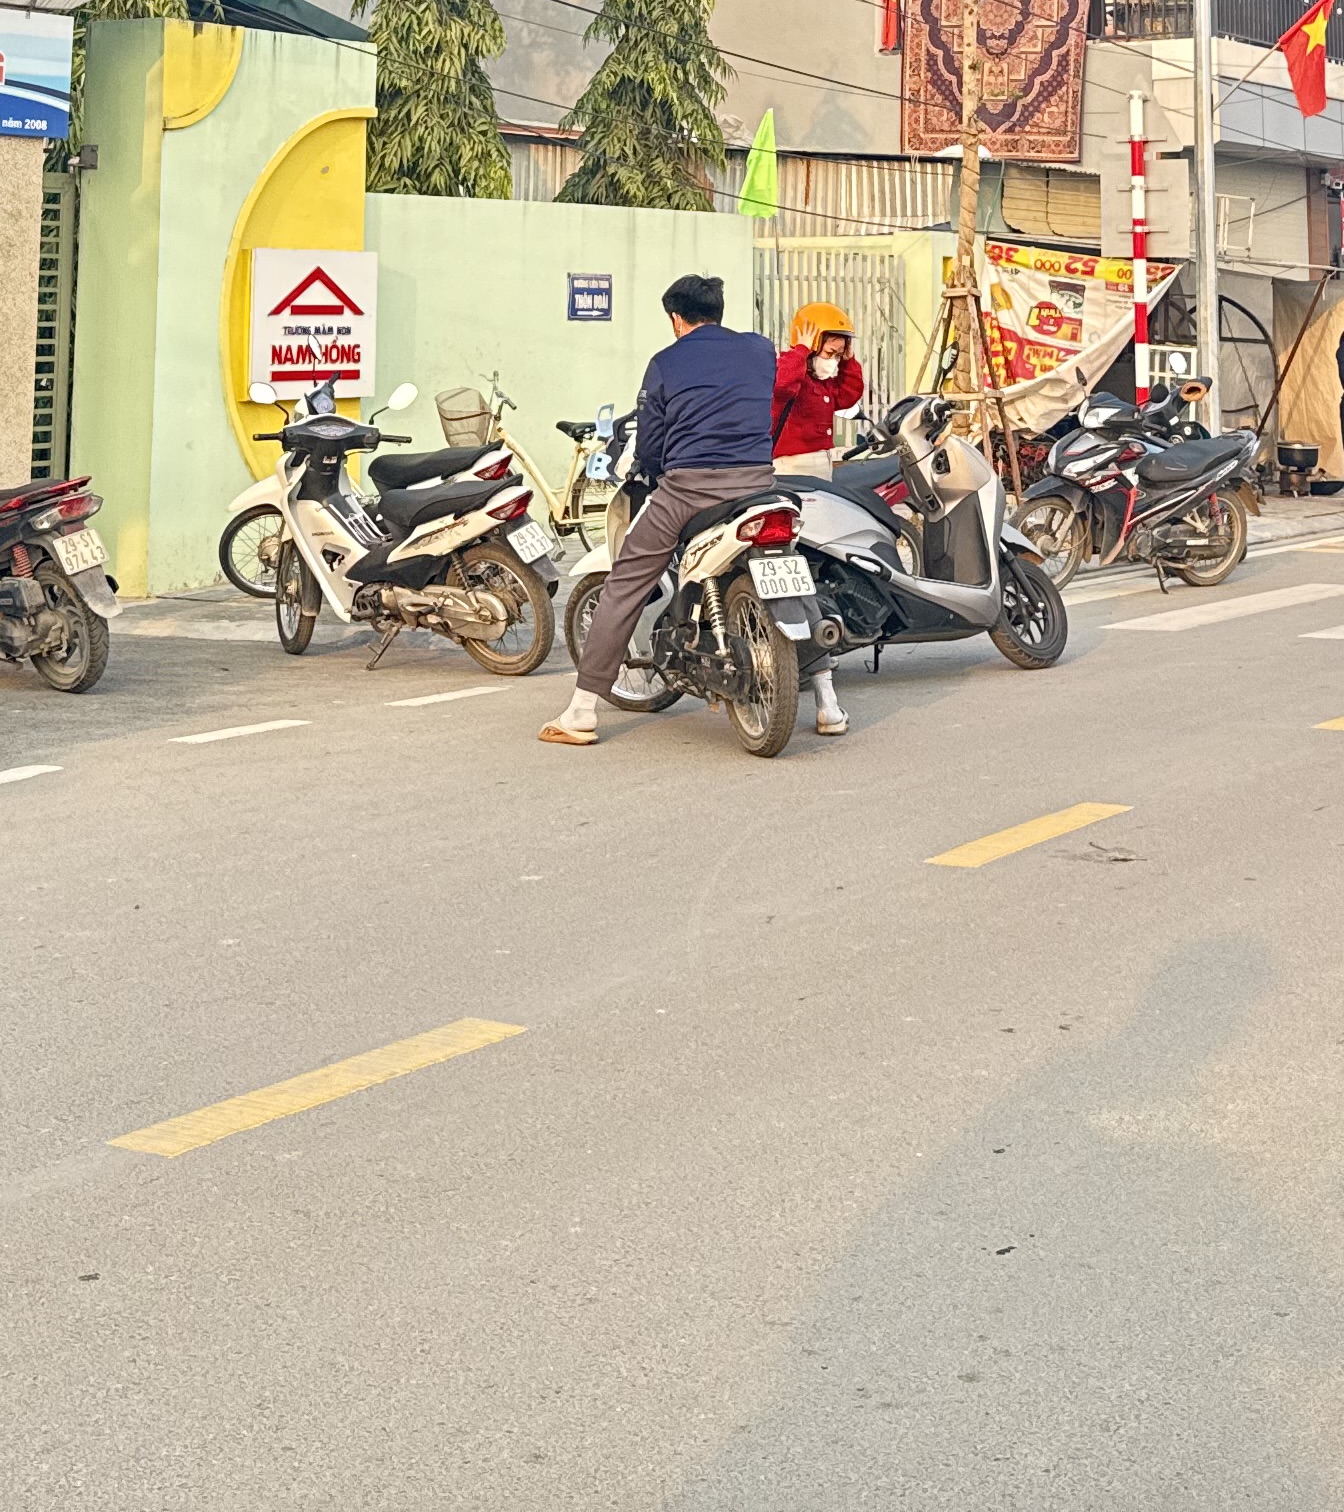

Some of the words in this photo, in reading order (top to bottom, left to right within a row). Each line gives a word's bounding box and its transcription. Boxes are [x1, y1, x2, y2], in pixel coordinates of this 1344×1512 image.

[2, 116, 23, 129] năm
[24, 118, 48, 130] 2008
[1034, 258, 1062, 273] 000
[1064, 255, 1100, 276] 52
[1116, 267, 1133, 280] 00
[271, 344, 314, 365] NAM
[61, 531, 96, 555] 29-S1
[758, 559, 802, 577] 29-S2
